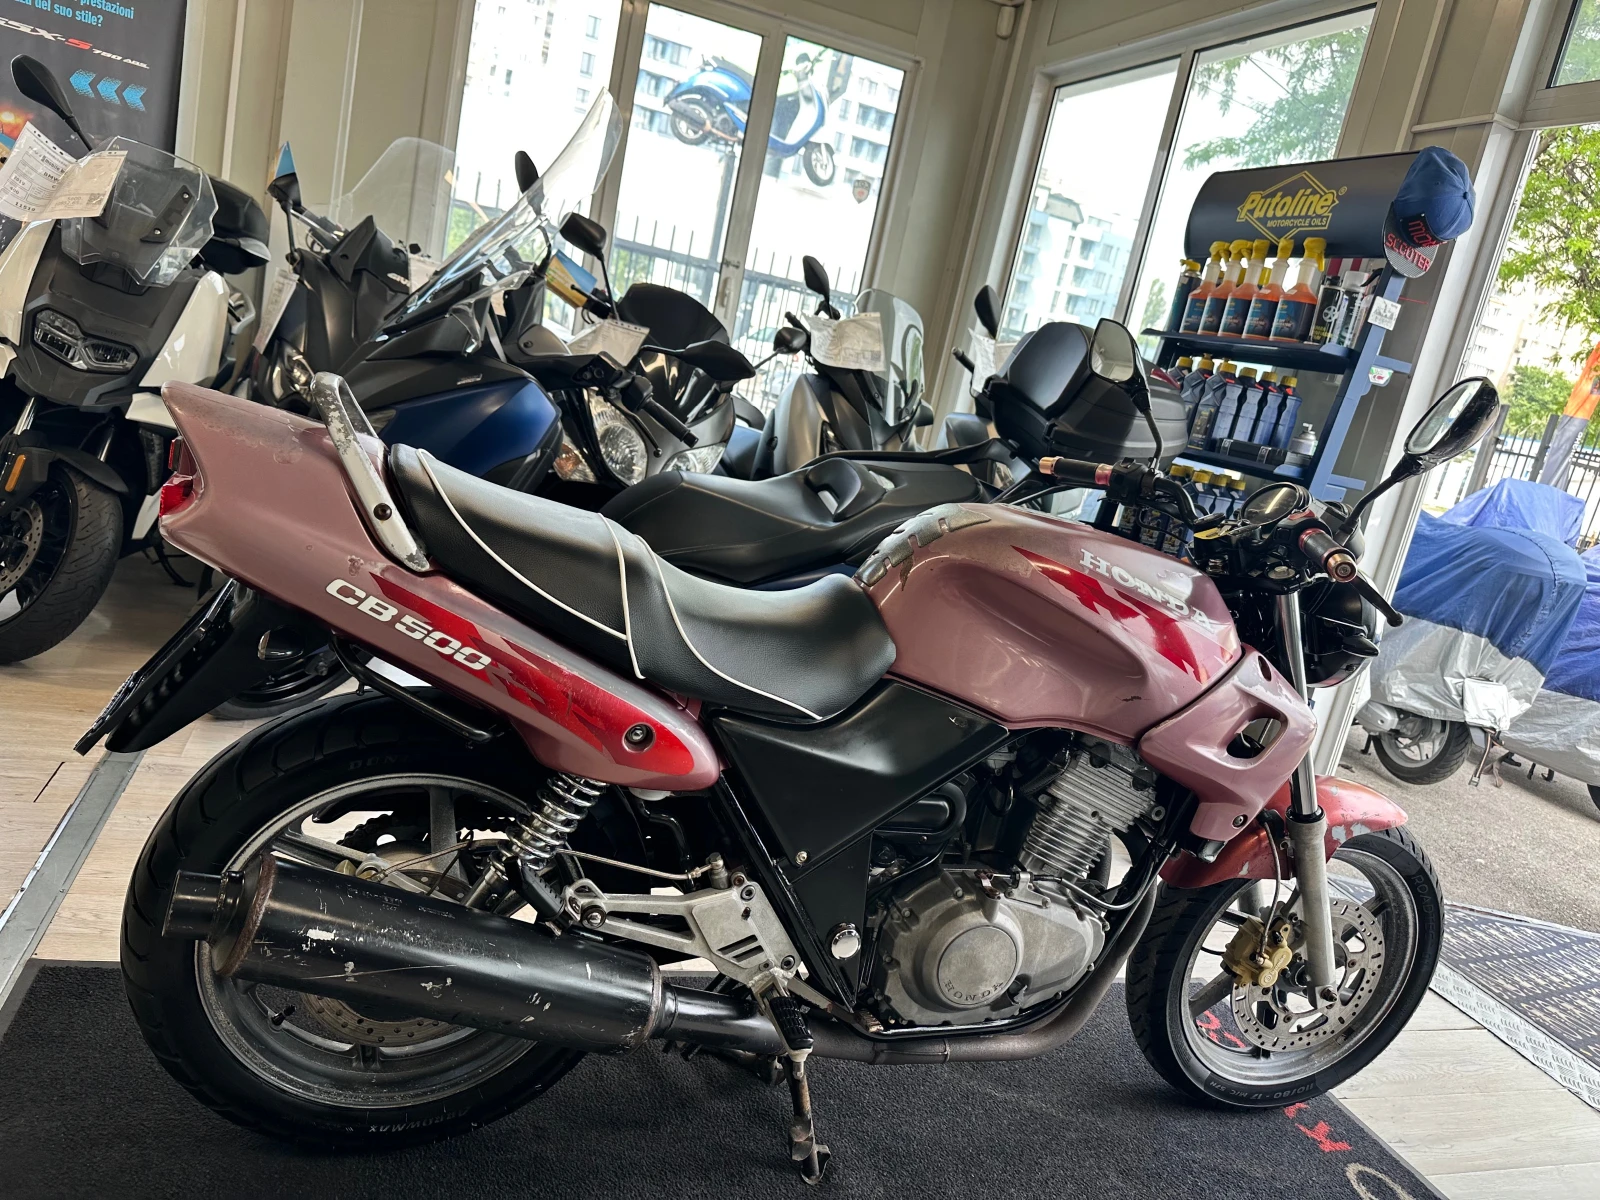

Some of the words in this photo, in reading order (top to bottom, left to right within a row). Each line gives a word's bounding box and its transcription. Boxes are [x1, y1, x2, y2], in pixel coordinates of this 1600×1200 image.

[53, 3, 73, 18] suo
[75, 10, 104, 27] stile?
[92, 48, 122, 61] 750
[1240, 188, 1334, 219] Putoline
[1267, 218, 1310, 228] MOTORCYCLE
[1311, 216, 1328, 226] OILS
[1385, 233, 1432, 273] SCOOTER
[1080, 548, 1217, 635] HONDA
[943, 979, 1004, 1001] HONDA
[1230, 1088, 1248, 1098] M/C
[1273, 1082, 1314, 1099] 110/80
